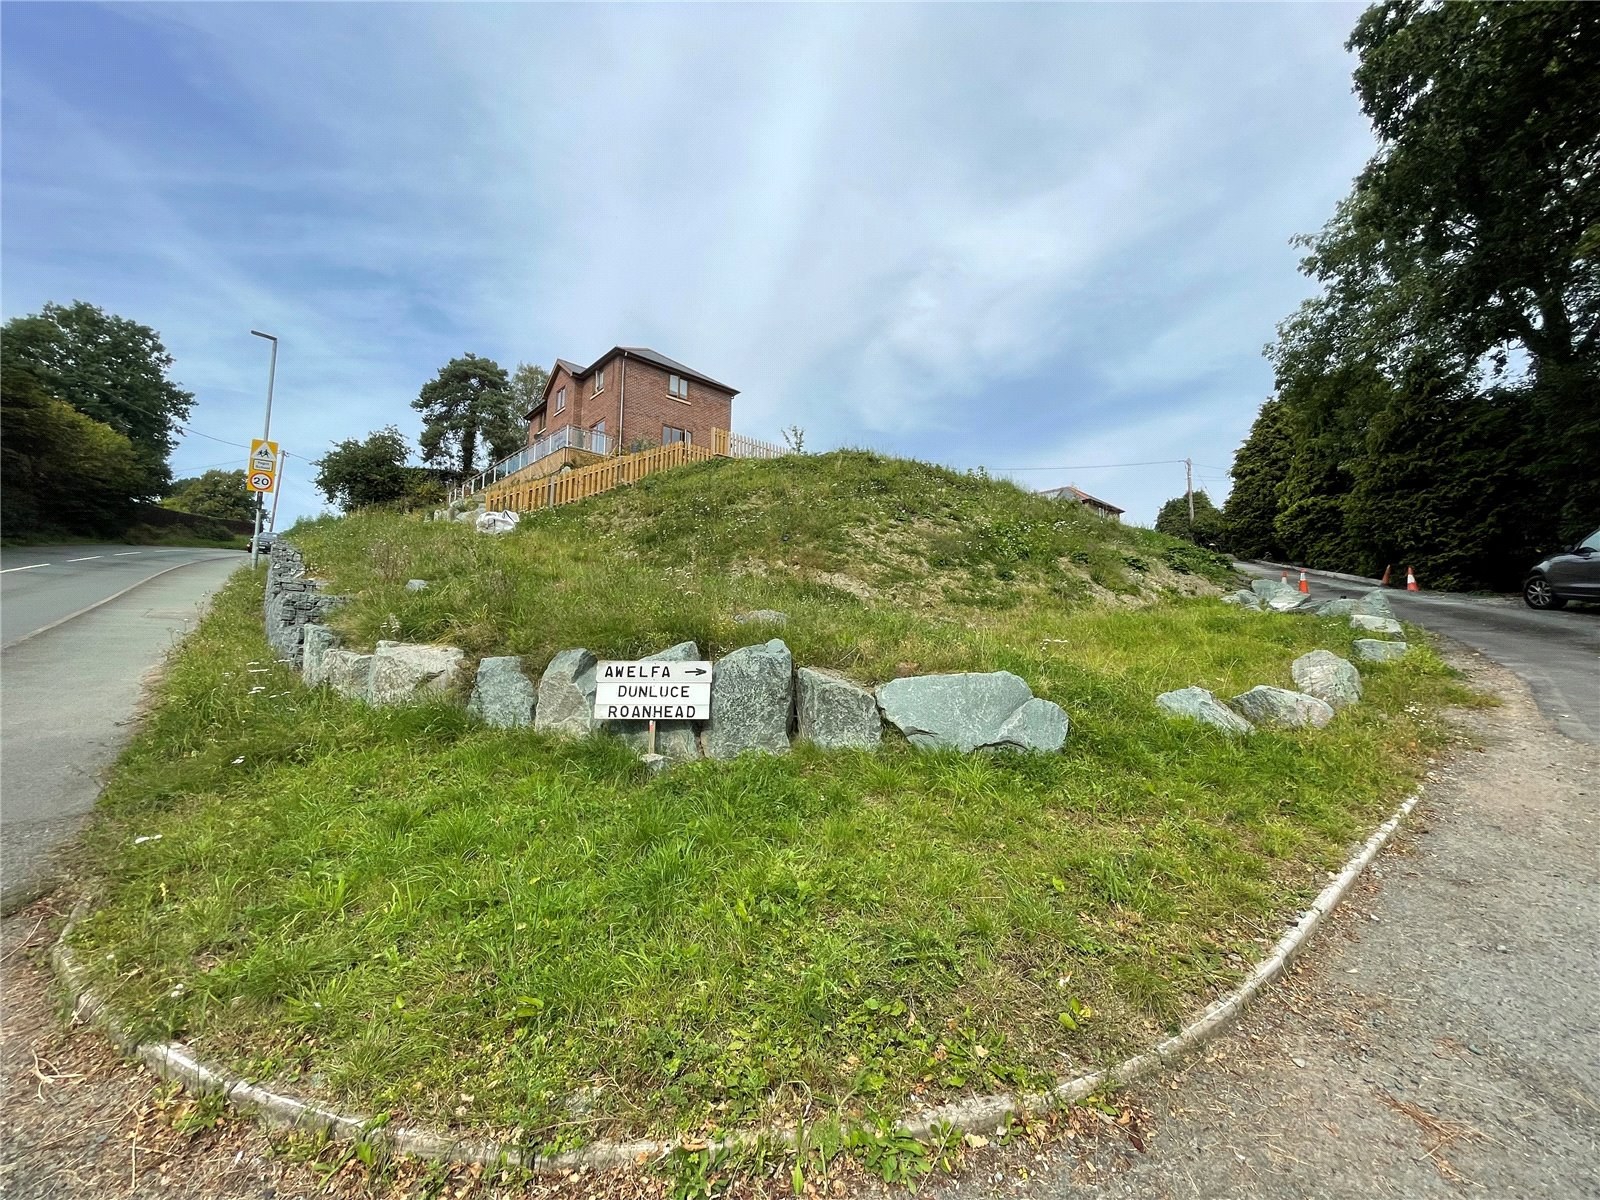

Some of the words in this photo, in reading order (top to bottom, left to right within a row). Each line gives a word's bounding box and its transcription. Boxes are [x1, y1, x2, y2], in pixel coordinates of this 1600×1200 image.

[253, 477, 269, 486] 20
[604, 665, 671, 678] AWELFA
[617, 685, 690, 698] DUNLUCE
[608, 705, 696, 718] ROANHEAD
